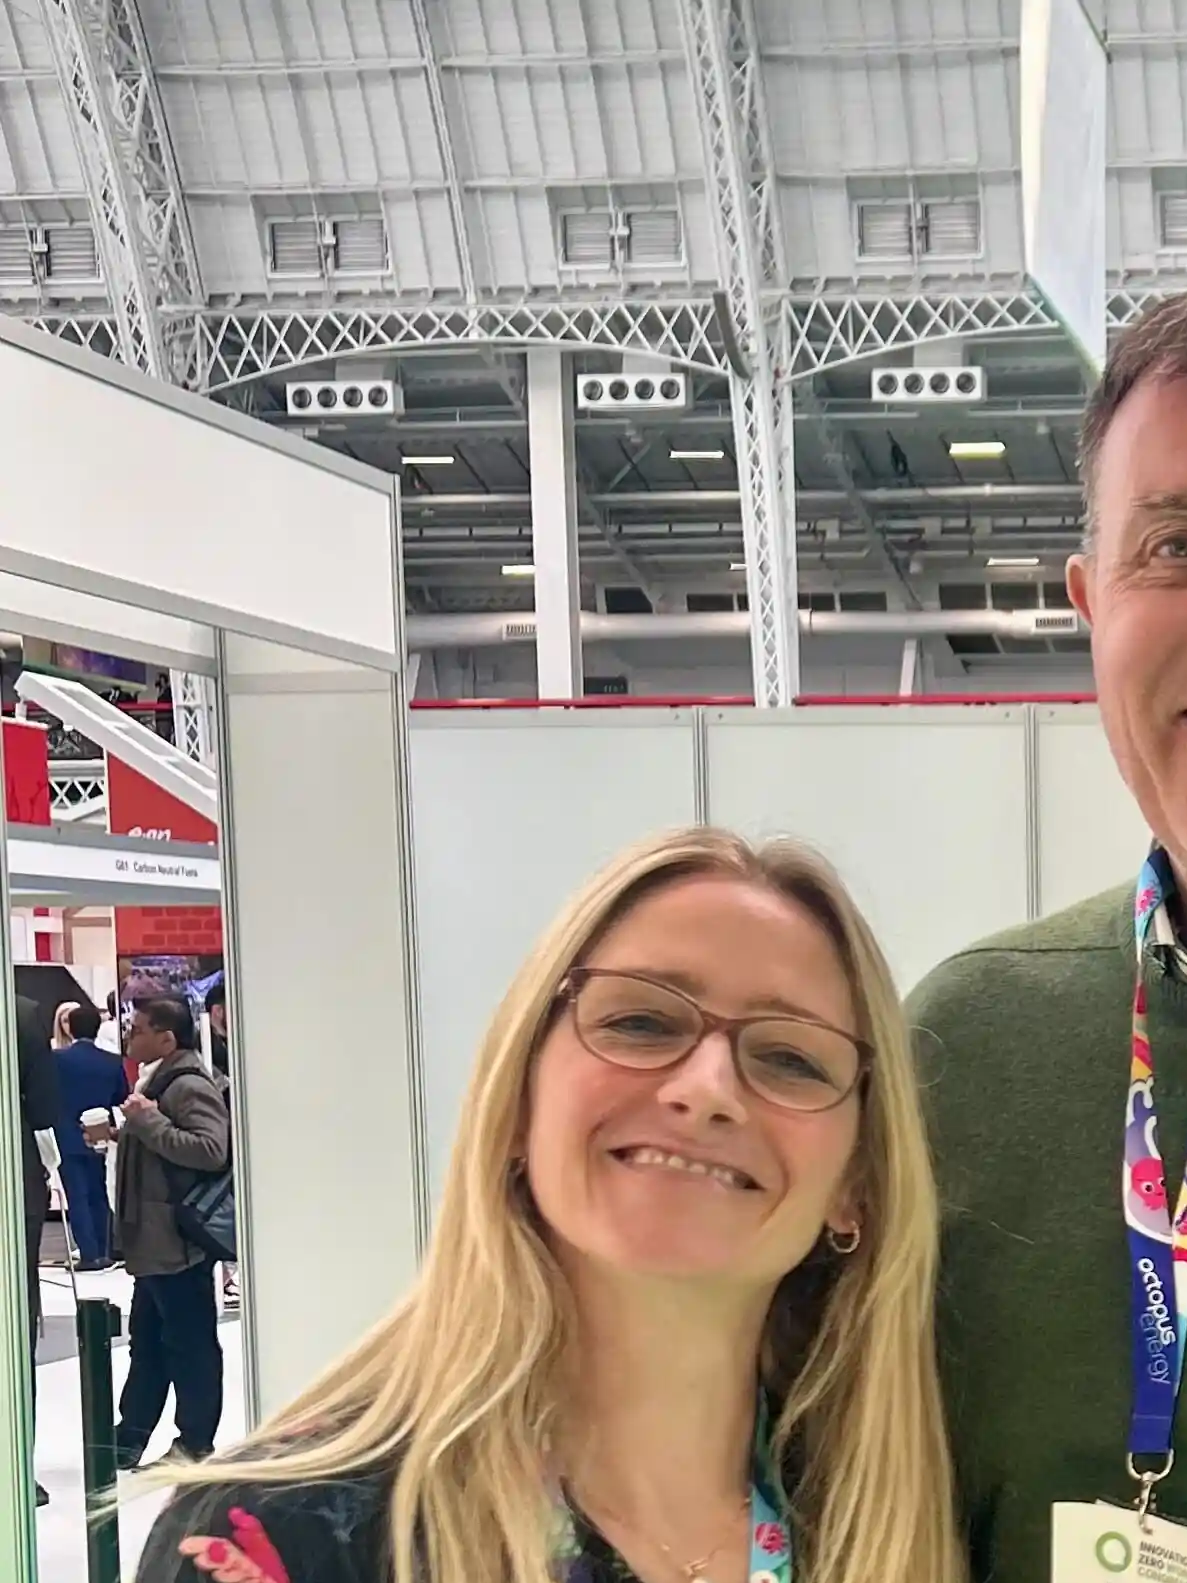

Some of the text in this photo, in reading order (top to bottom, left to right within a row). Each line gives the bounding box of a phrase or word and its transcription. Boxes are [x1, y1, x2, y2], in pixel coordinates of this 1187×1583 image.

[134, 861, 156, 874] Carbon
[1137, 1257, 1176, 1346] octopus
[1140, 1312, 1171, 1385] energy
[1138, 1554, 1164, 1570] ZERO
